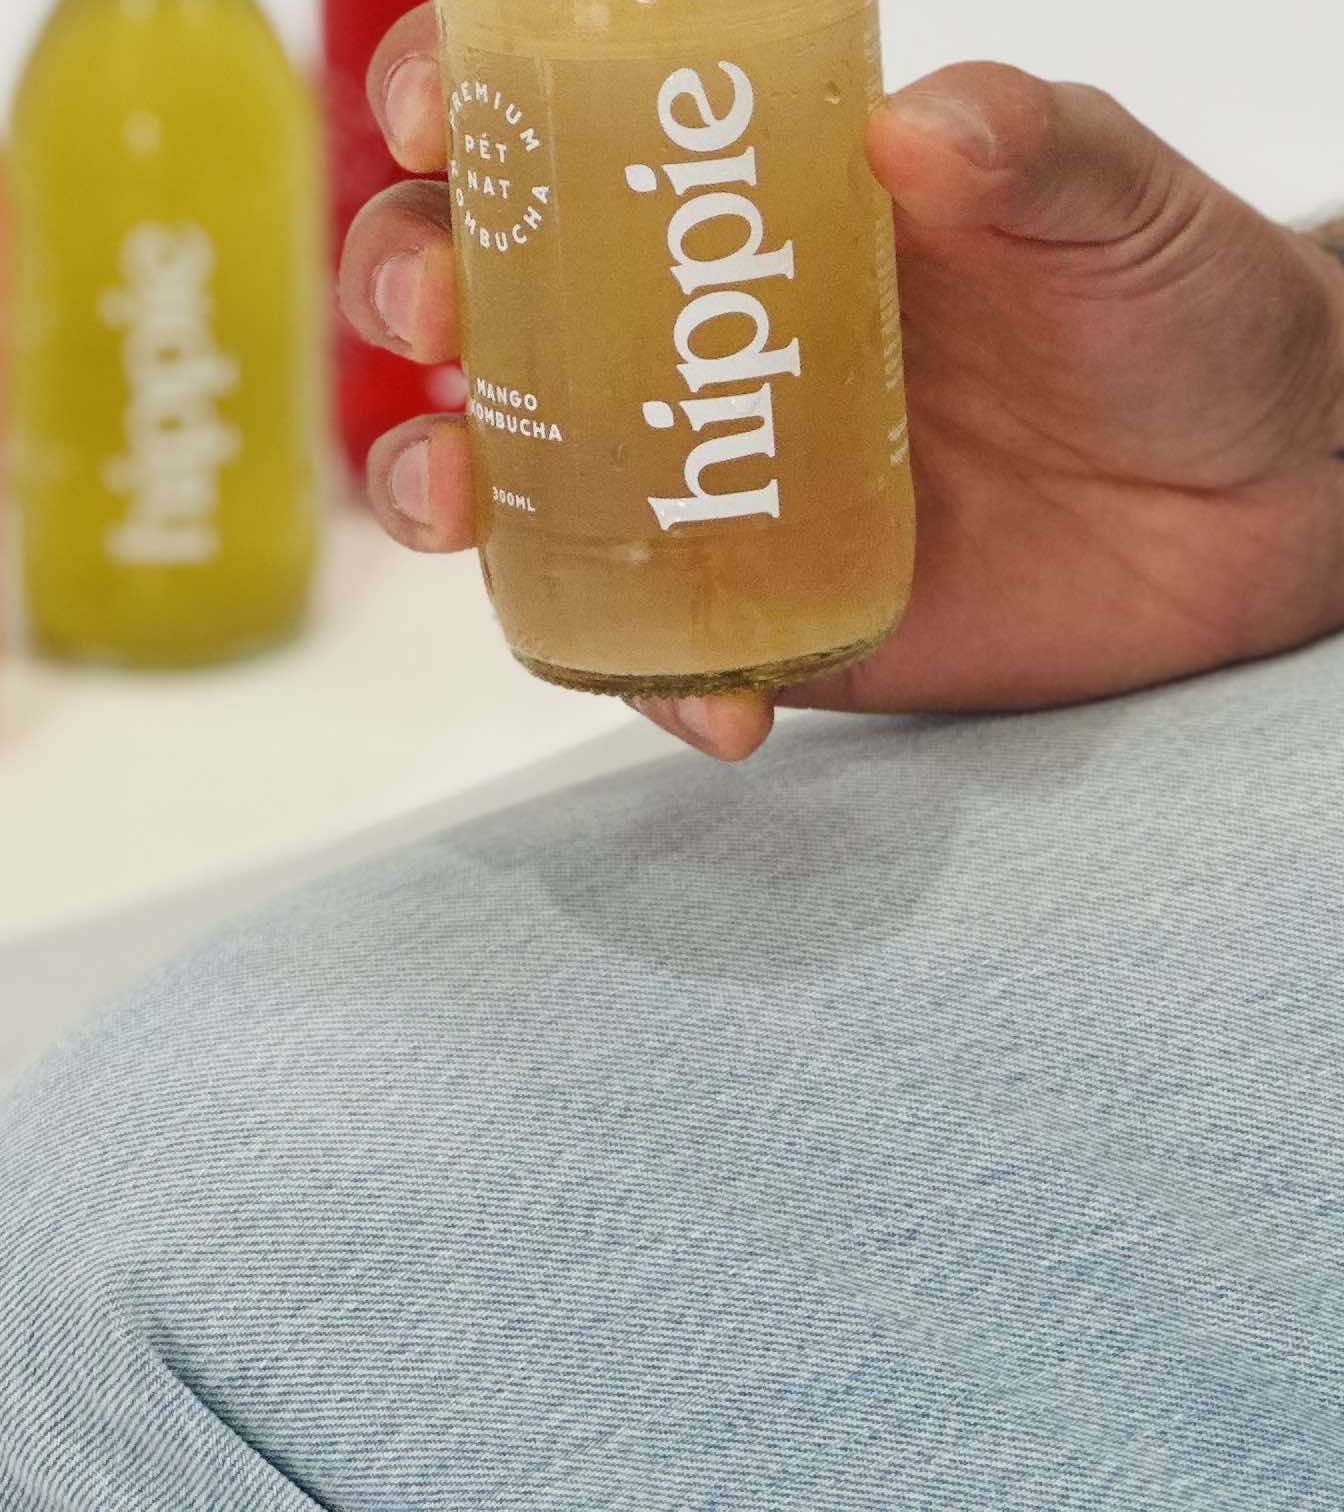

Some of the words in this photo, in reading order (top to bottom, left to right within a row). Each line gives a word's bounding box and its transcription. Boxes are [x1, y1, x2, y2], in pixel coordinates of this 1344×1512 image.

[467, 169, 510, 199] NAT
[624, 60, 801, 531] hippie
[476, 377, 538, 412] MANGO
[492, 486, 536, 512] 300ML
